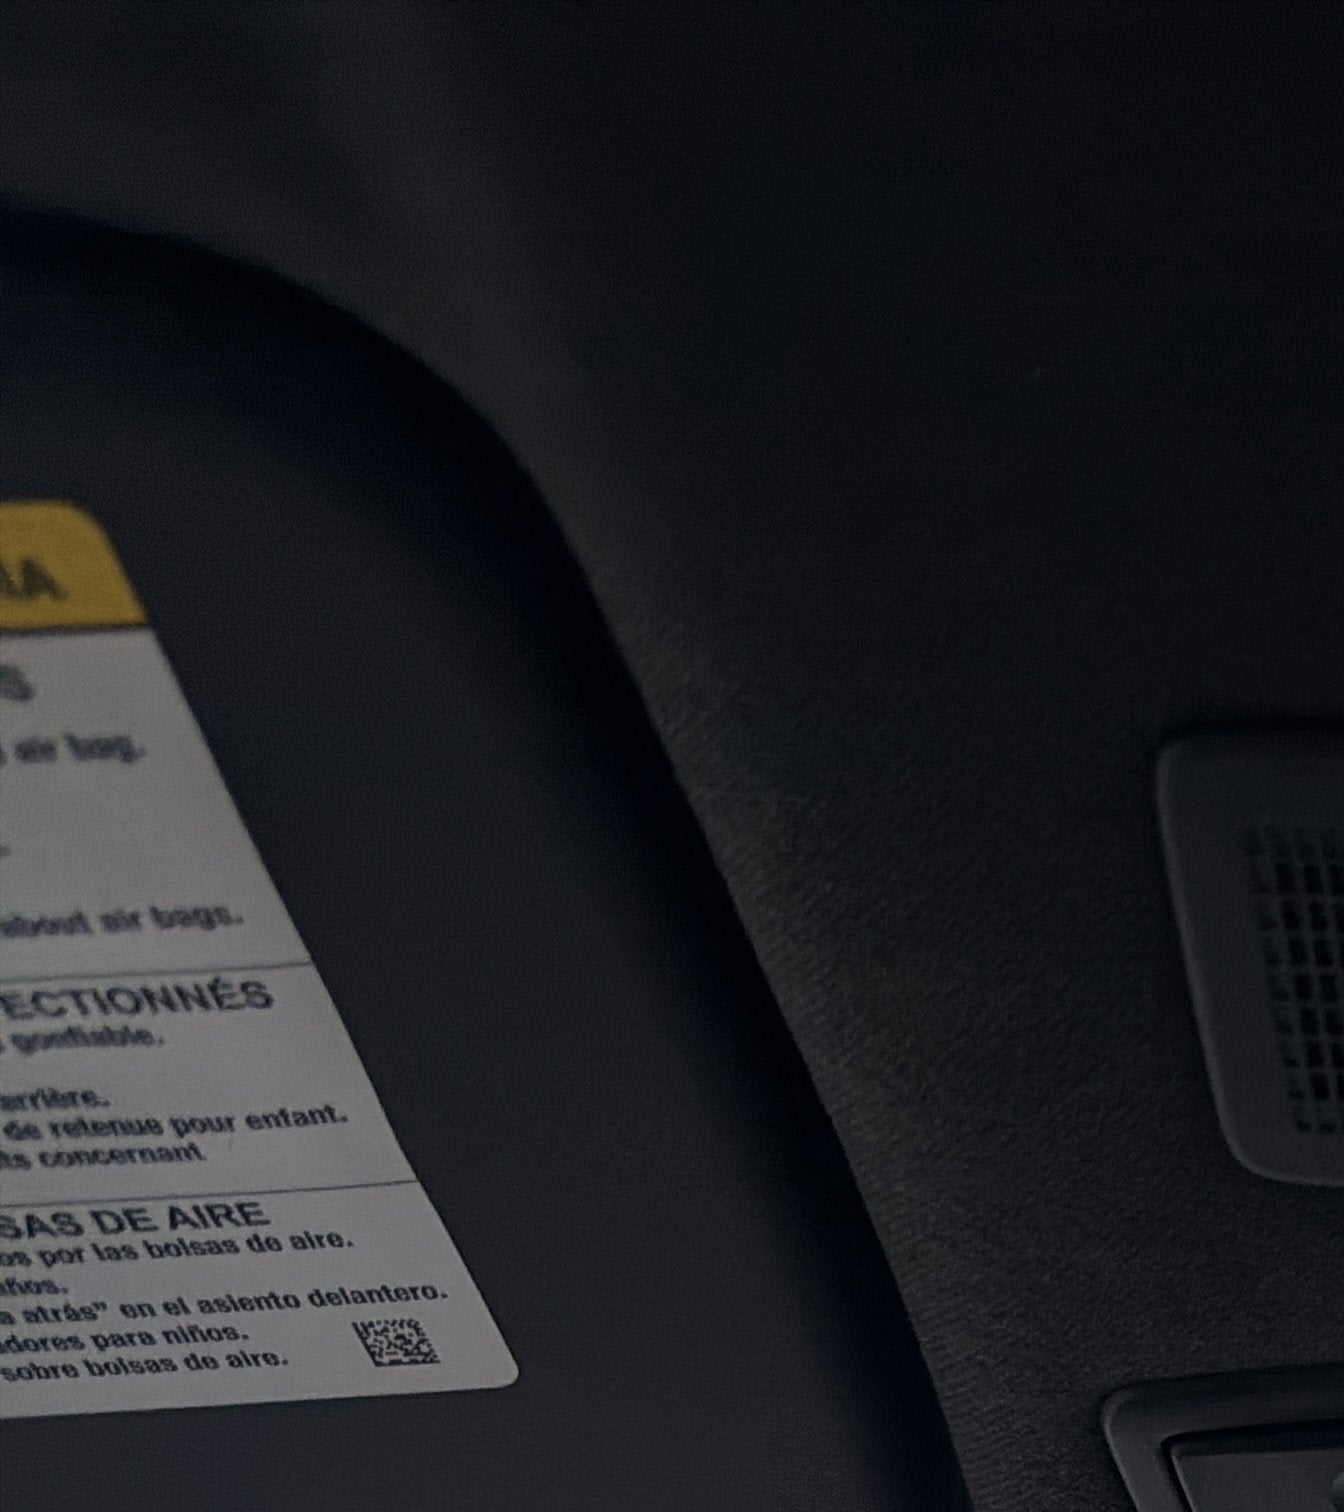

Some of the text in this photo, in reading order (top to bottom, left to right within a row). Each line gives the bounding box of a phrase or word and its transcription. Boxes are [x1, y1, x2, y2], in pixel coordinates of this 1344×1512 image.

[49, 1114, 164, 1139] retenue
[168, 1114, 236, 1138] pour
[245, 1104, 348, 1131] enfant.
[39, 1143, 206, 1167] concernant
[89, 1206, 159, 1235] DE
[168, 1201, 271, 1230] AIRE
[38, 1248, 85, 1268] por
[91, 1243, 139, 1263] las
[143, 1237, 240, 1259] bolsas
[246, 1233, 282, 1253] de
[291, 1230, 355, 1250] aire.
[119, 1302, 157, 1319] en
[163, 1297, 191, 1316] el
[197, 1291, 301, 1312] asiento
[308, 1283, 448, 1308] delantero.
[90, 1331, 154, 1351] para
[162, 1323, 249, 1343] niños.
[0, 1348, 288, 1381] sobre bolsas de aire.
